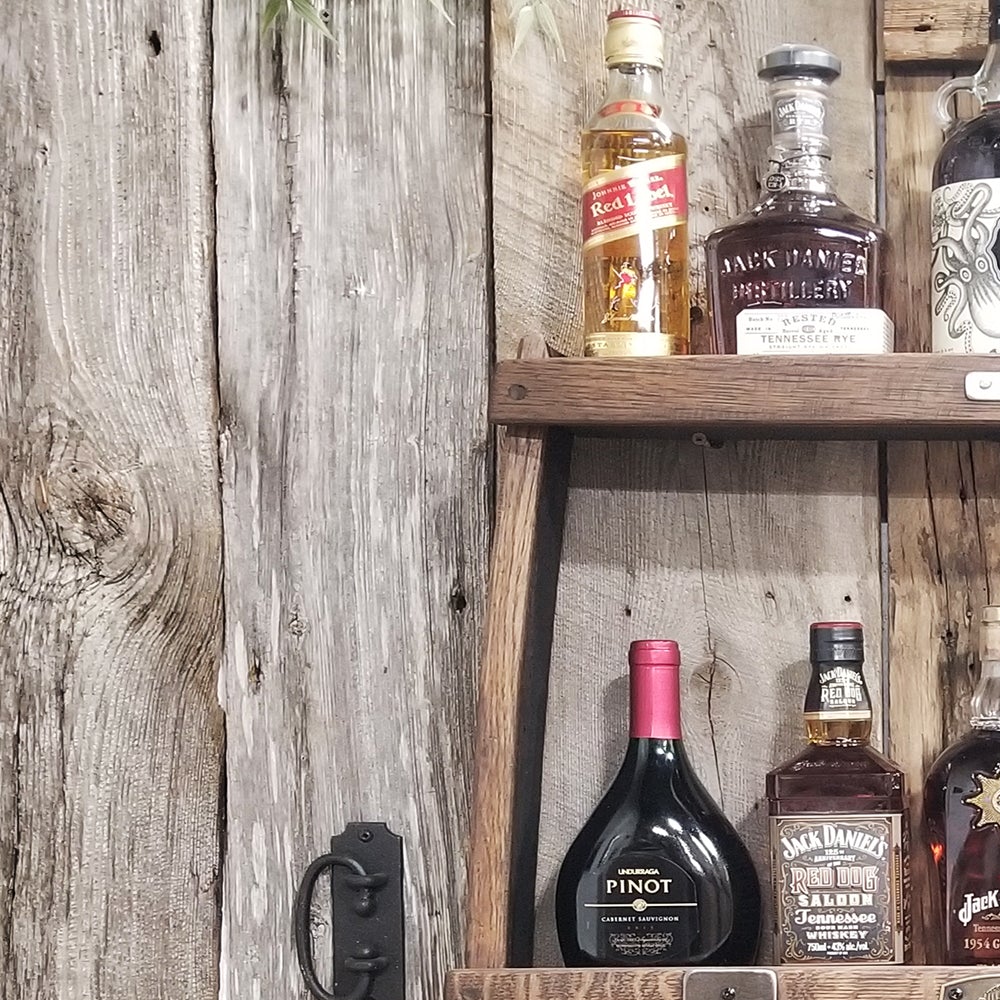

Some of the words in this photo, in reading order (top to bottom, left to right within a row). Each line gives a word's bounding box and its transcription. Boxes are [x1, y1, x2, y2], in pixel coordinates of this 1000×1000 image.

[592, 184, 627, 201] JOHNNIE
[590, 196, 624, 218] Red
[720, 249, 778, 276] JACK
[733, 267, 852, 300] DISTILLERY
[782, 313, 837, 327] RESTED
[761, 334, 829, 343] TENNESSEE
[834, 334, 857, 343] RYE
[819, 671, 836, 685] JACK
[821, 687, 843, 703] RED
[781, 830, 824, 861] JACK
[822, 824, 889, 861] DANIEL'S
[606, 878, 673, 895] PINOT
[790, 866, 835, 894] RED
[797, 893, 874, 907] SALOON
[958, 889, 1000, 927] Jack
[794, 909, 877, 925] Tennessee
[806, 931, 869, 940] WHISKEY
[964, 938, 991, 950] 1954
